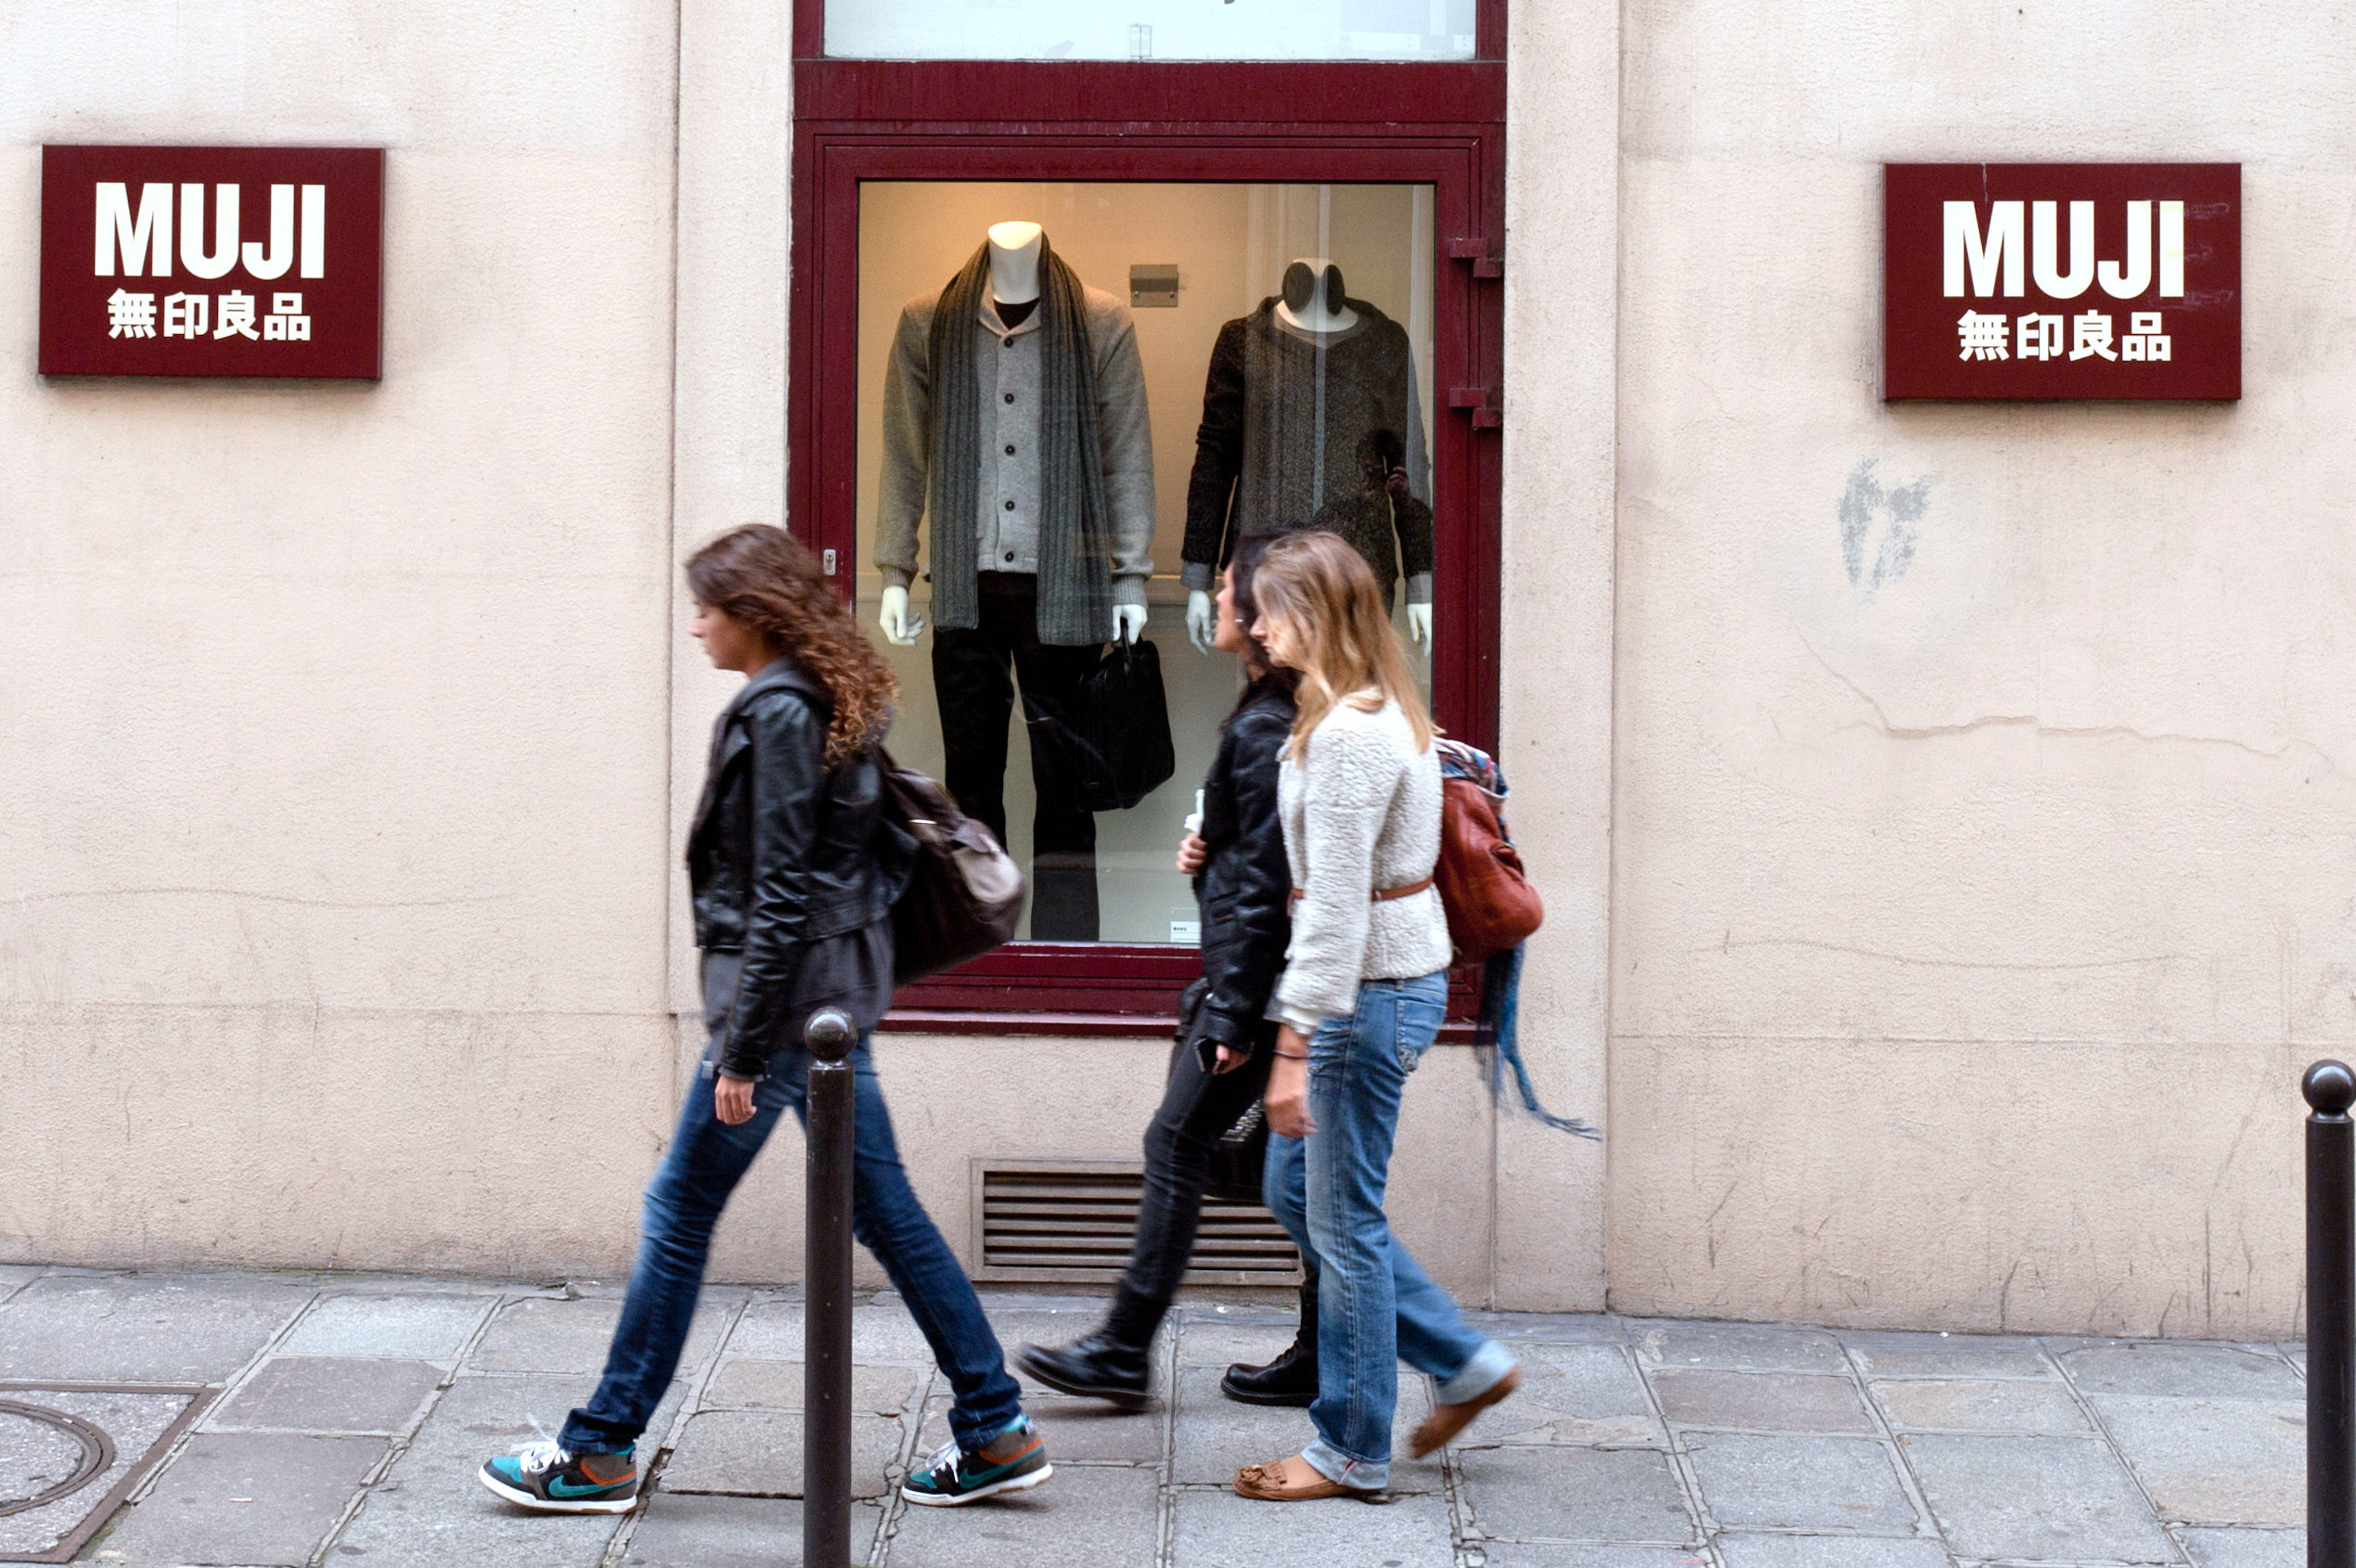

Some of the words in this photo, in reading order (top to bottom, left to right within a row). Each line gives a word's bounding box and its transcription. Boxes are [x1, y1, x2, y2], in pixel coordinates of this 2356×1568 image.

[95, 183, 325, 279] MUJI
[1943, 200, 2184, 299] MUJI
[108, 289, 311, 341] 無印良品
[1958, 310, 2171, 361] 無印良品
